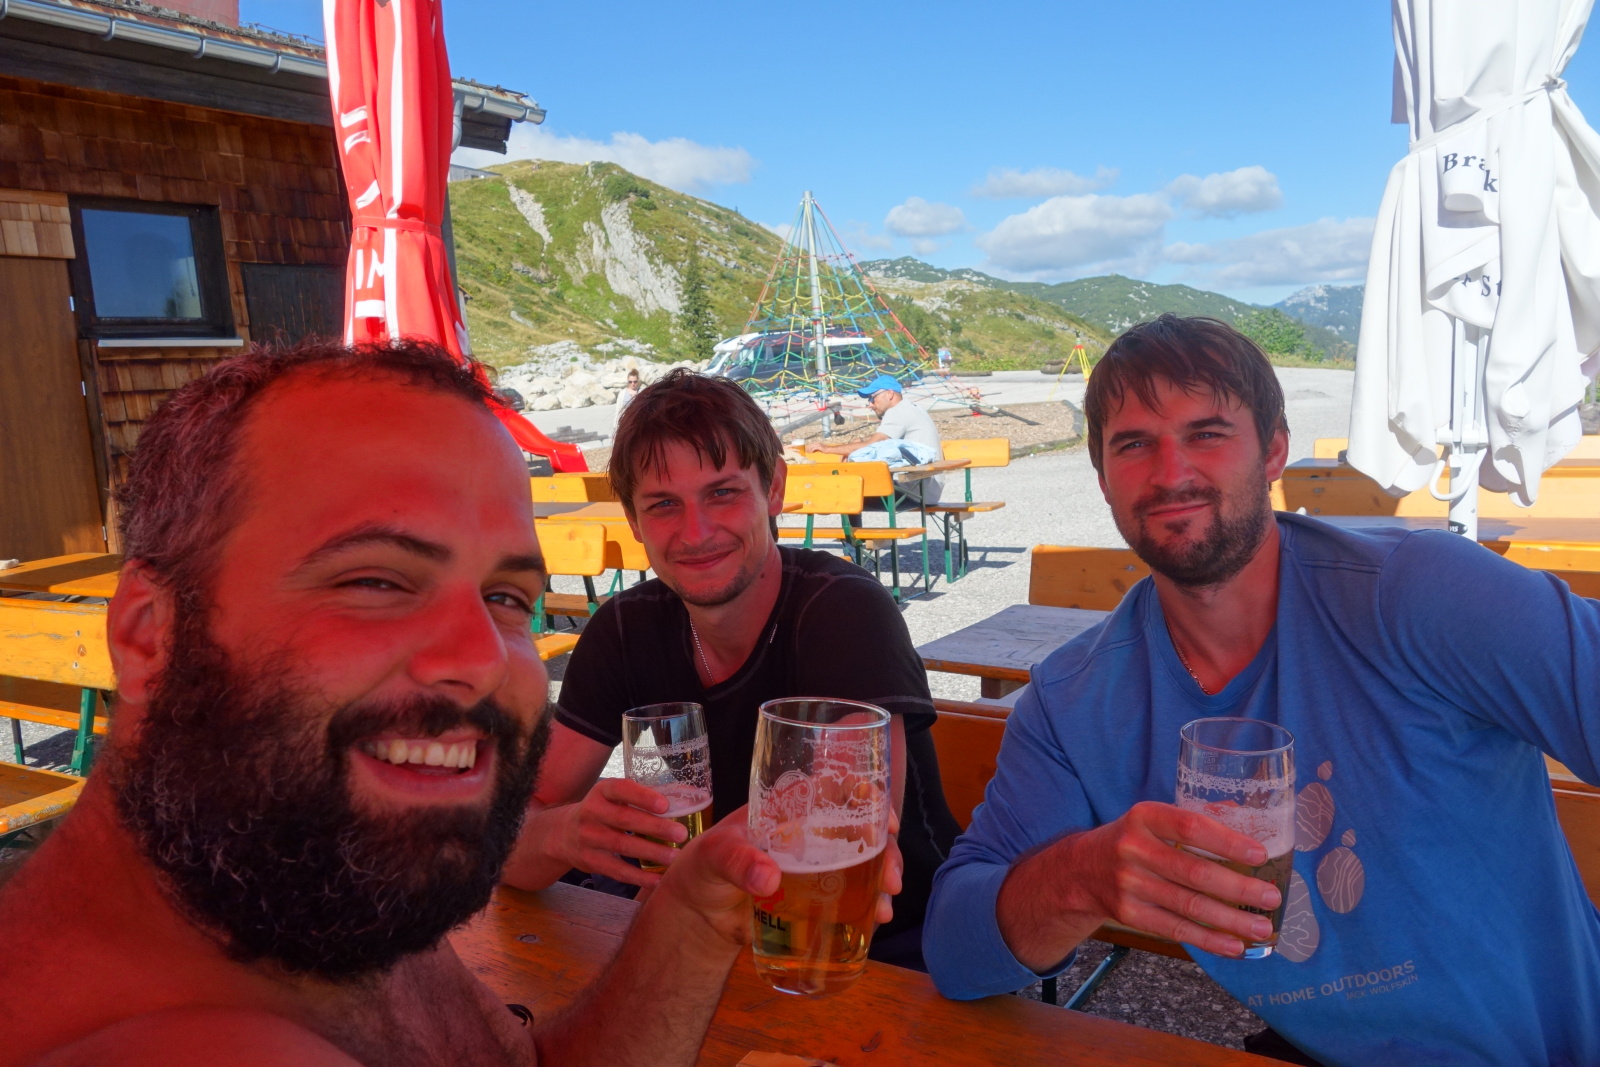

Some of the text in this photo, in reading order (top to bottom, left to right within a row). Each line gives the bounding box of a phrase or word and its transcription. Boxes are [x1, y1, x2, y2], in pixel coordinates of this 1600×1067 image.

[753, 904, 786, 932] HELL
[1248, 960, 1416, 1007] AT HOME OUTDOORS
[1346, 974, 1419, 1000] JACK WOLFSKIN
